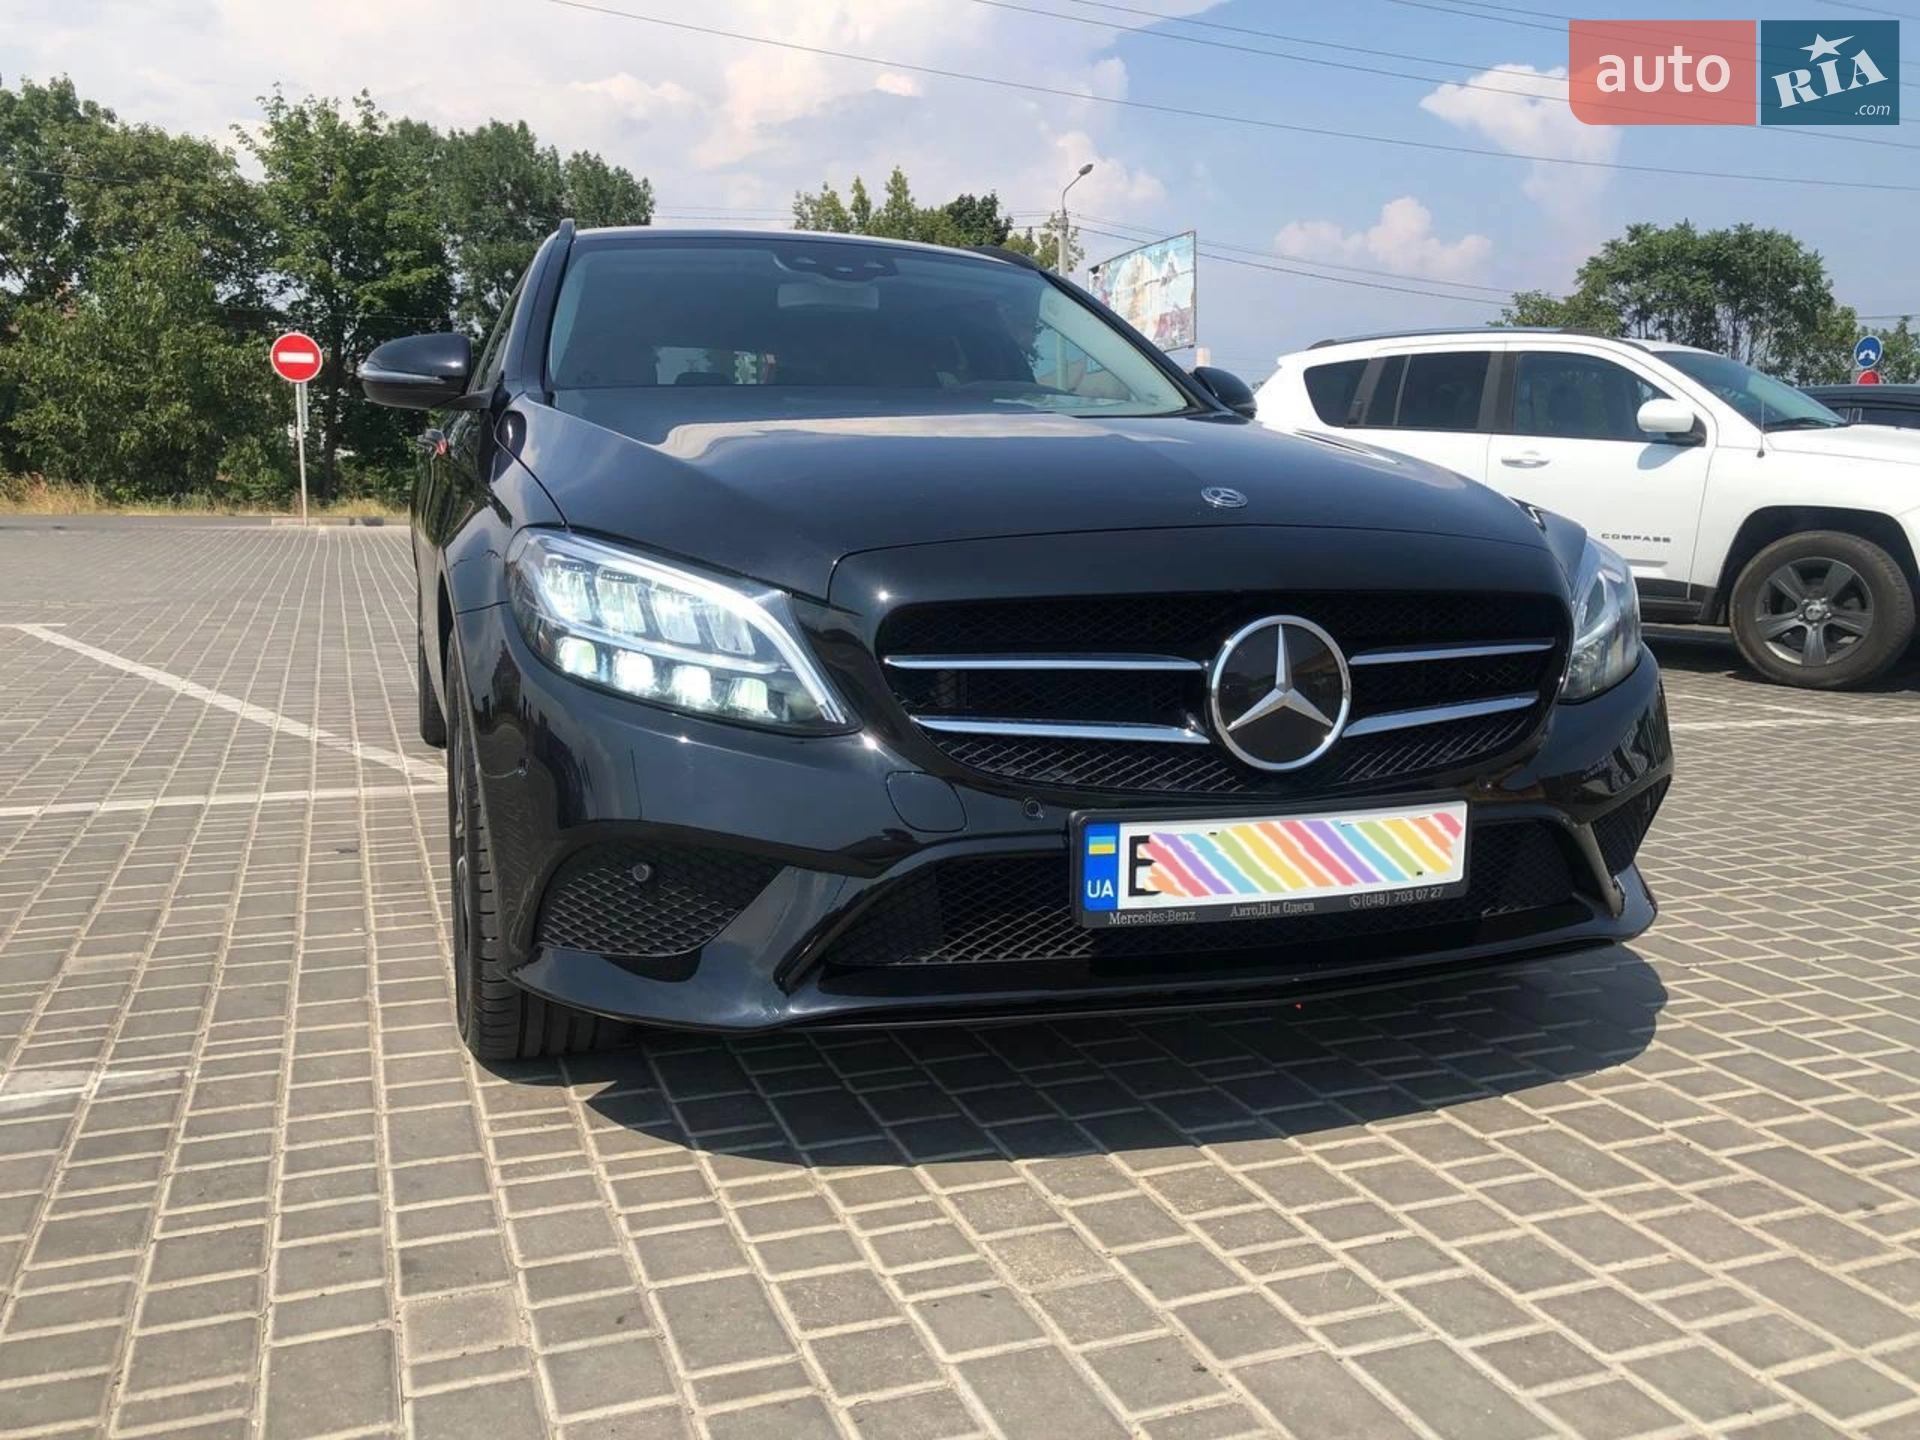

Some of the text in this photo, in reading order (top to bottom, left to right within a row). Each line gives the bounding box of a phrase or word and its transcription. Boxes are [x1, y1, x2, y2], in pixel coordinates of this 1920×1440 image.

[1601, 532, 1671, 544] COMPASS
[1086, 879, 1115, 898] UA
[1361, 885, 1444, 909] (048) 703 07 27
[1109, 909, 1197, 925] Mercedes-Benz
